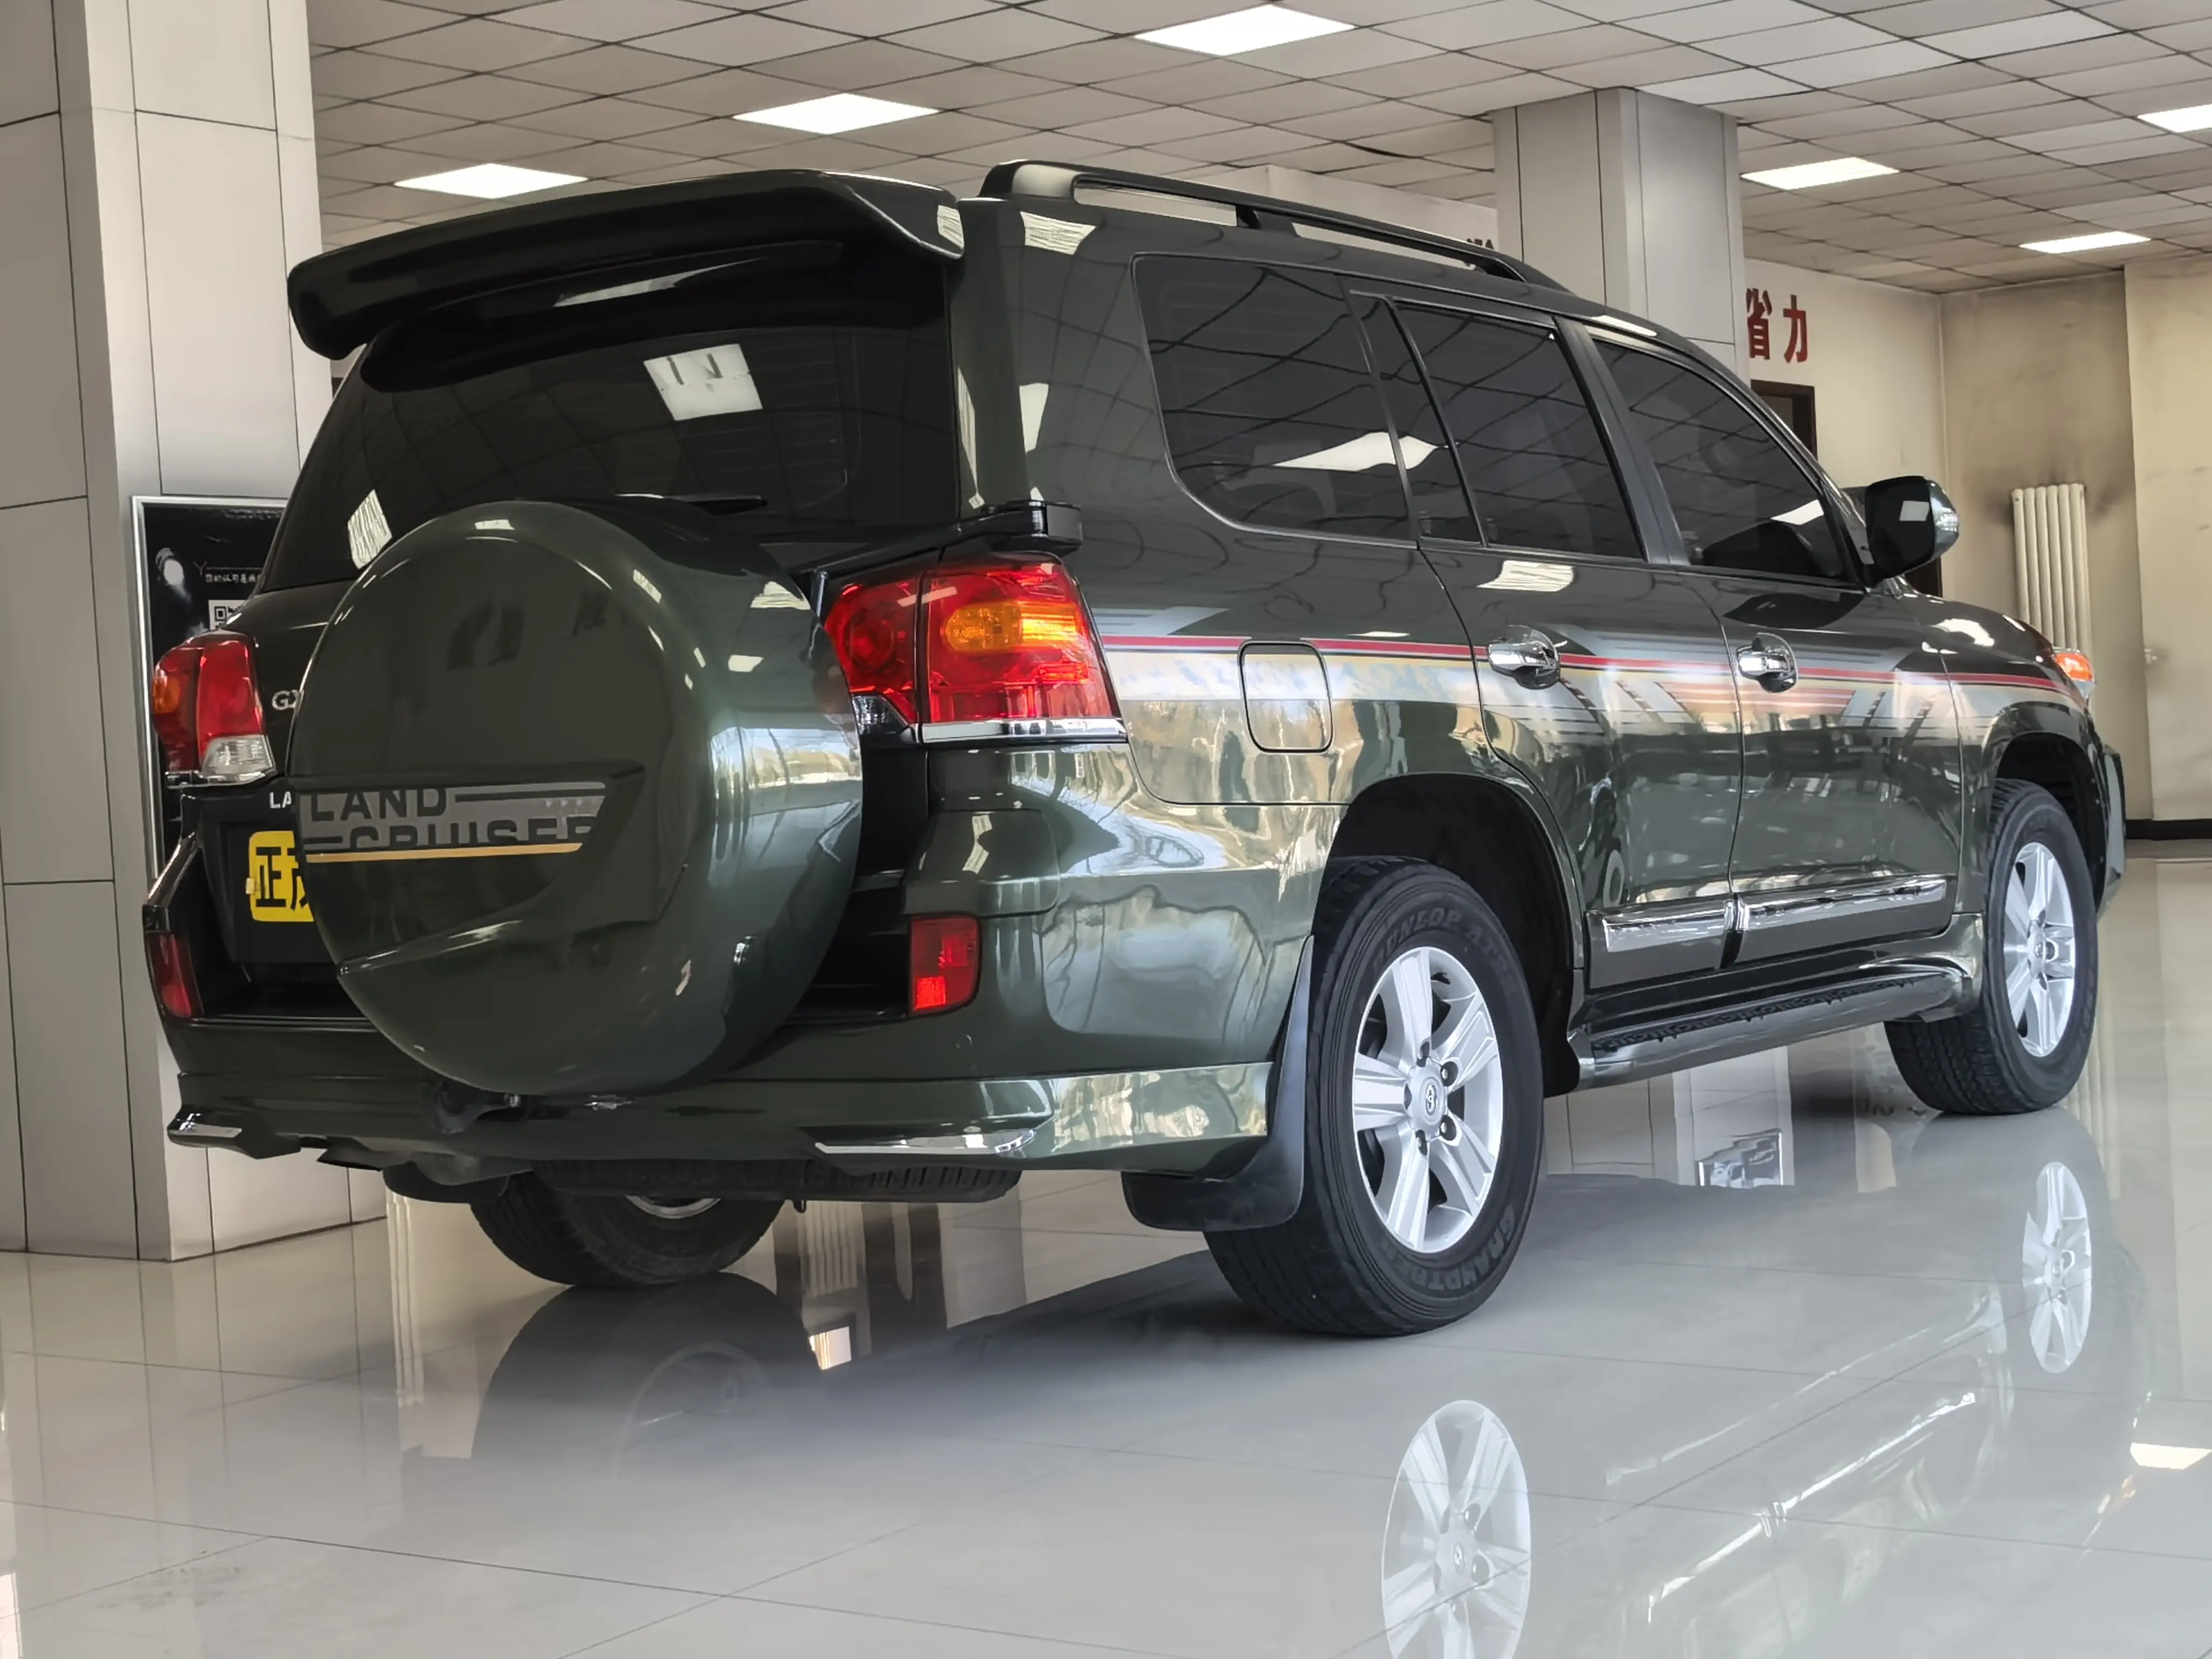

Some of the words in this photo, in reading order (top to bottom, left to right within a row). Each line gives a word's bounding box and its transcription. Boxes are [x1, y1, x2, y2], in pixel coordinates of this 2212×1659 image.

[1746, 288, 1808, 363] 省力
[311, 788, 447, 821] LAND
[1373, 907, 1462, 975] DUNLOP
